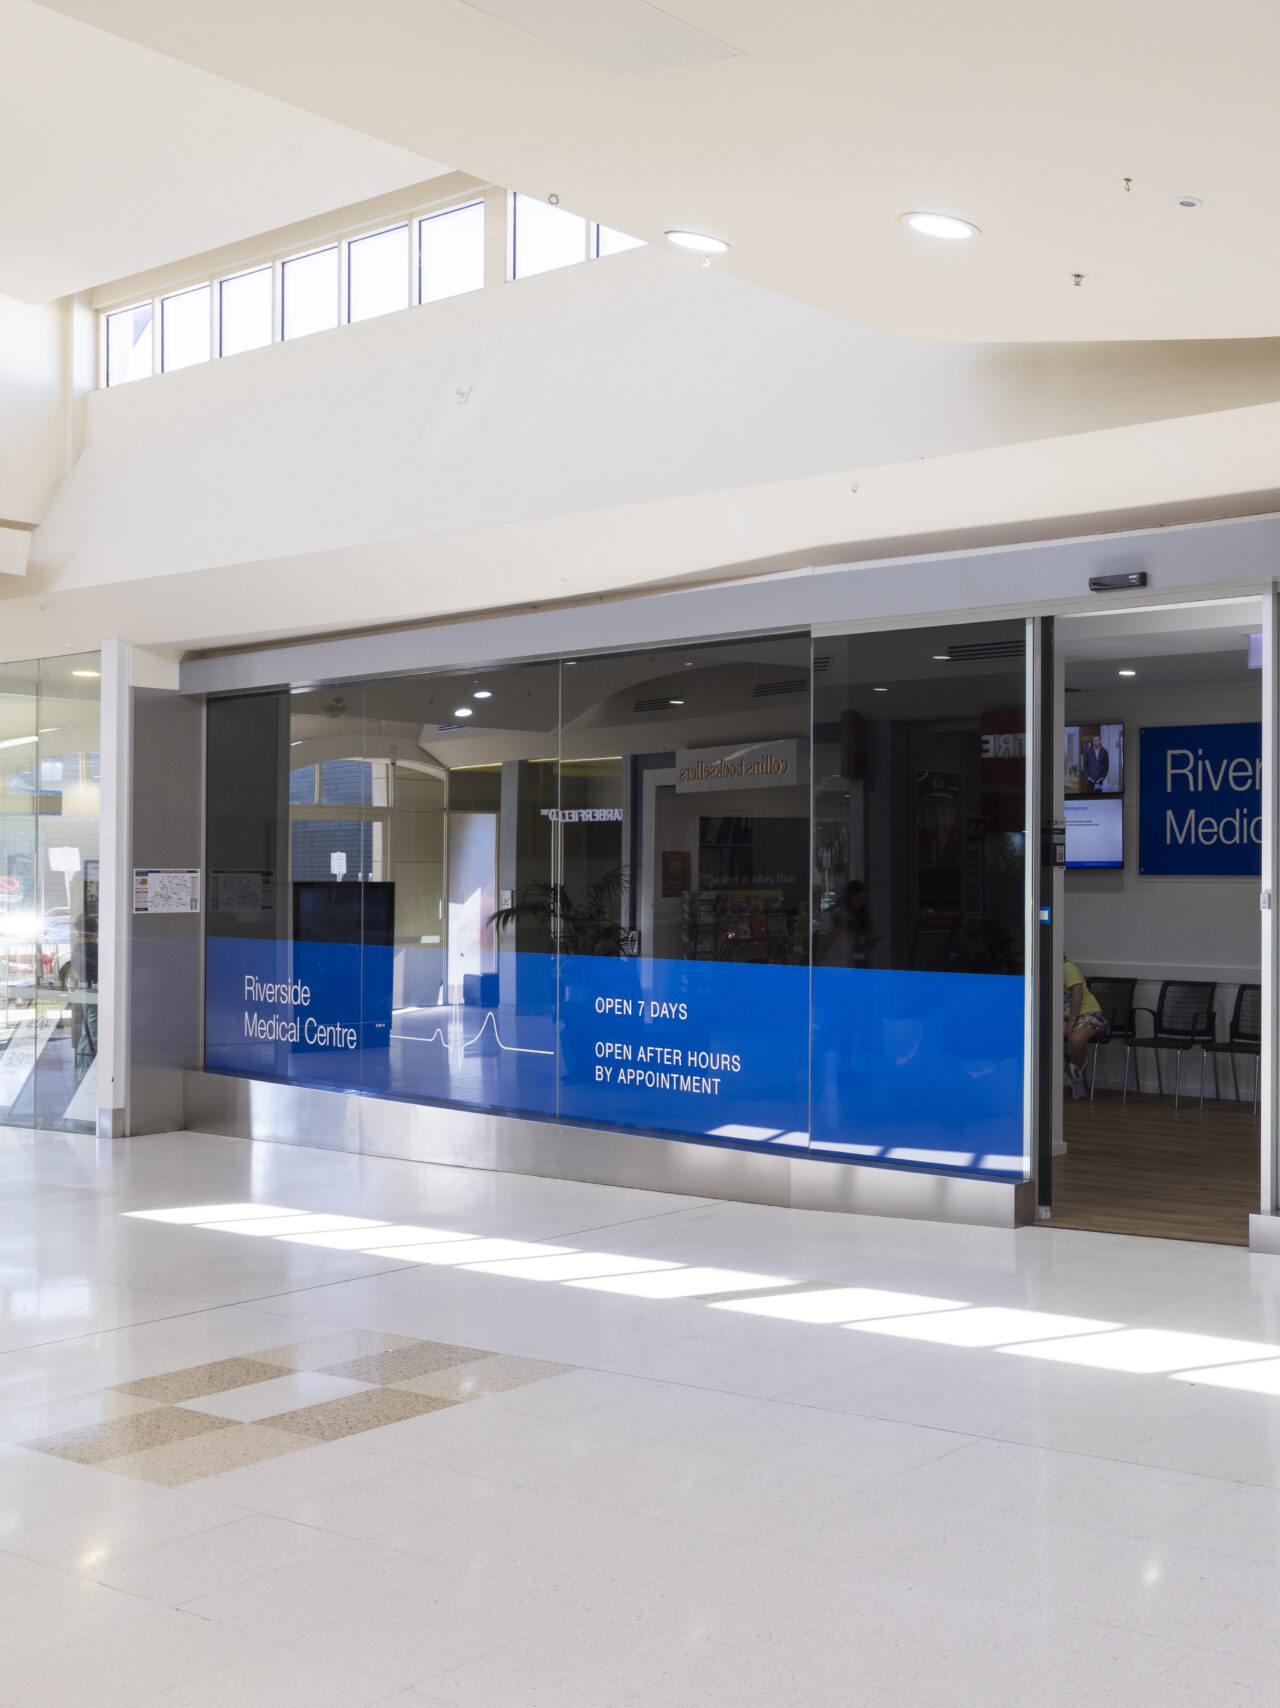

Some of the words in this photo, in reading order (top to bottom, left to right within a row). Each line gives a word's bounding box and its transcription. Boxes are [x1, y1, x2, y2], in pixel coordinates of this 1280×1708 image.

[244, 975, 311, 1006] Riverside
[595, 997, 633, 1016] OPEN
[637, 1000, 645, 1017] 7
[650, 1001, 688, 1020] DAYS
[244, 1011, 300, 1043] Medical
[304, 1017, 357, 1049] Centre
[595, 1041, 632, 1061] OPEN
[637, 1046, 682, 1066] AFTER
[687, 1050, 741, 1072] HOURS
[595, 1065, 613, 1082] BY
[617, 1067, 721, 1095] APPOINTMENT
